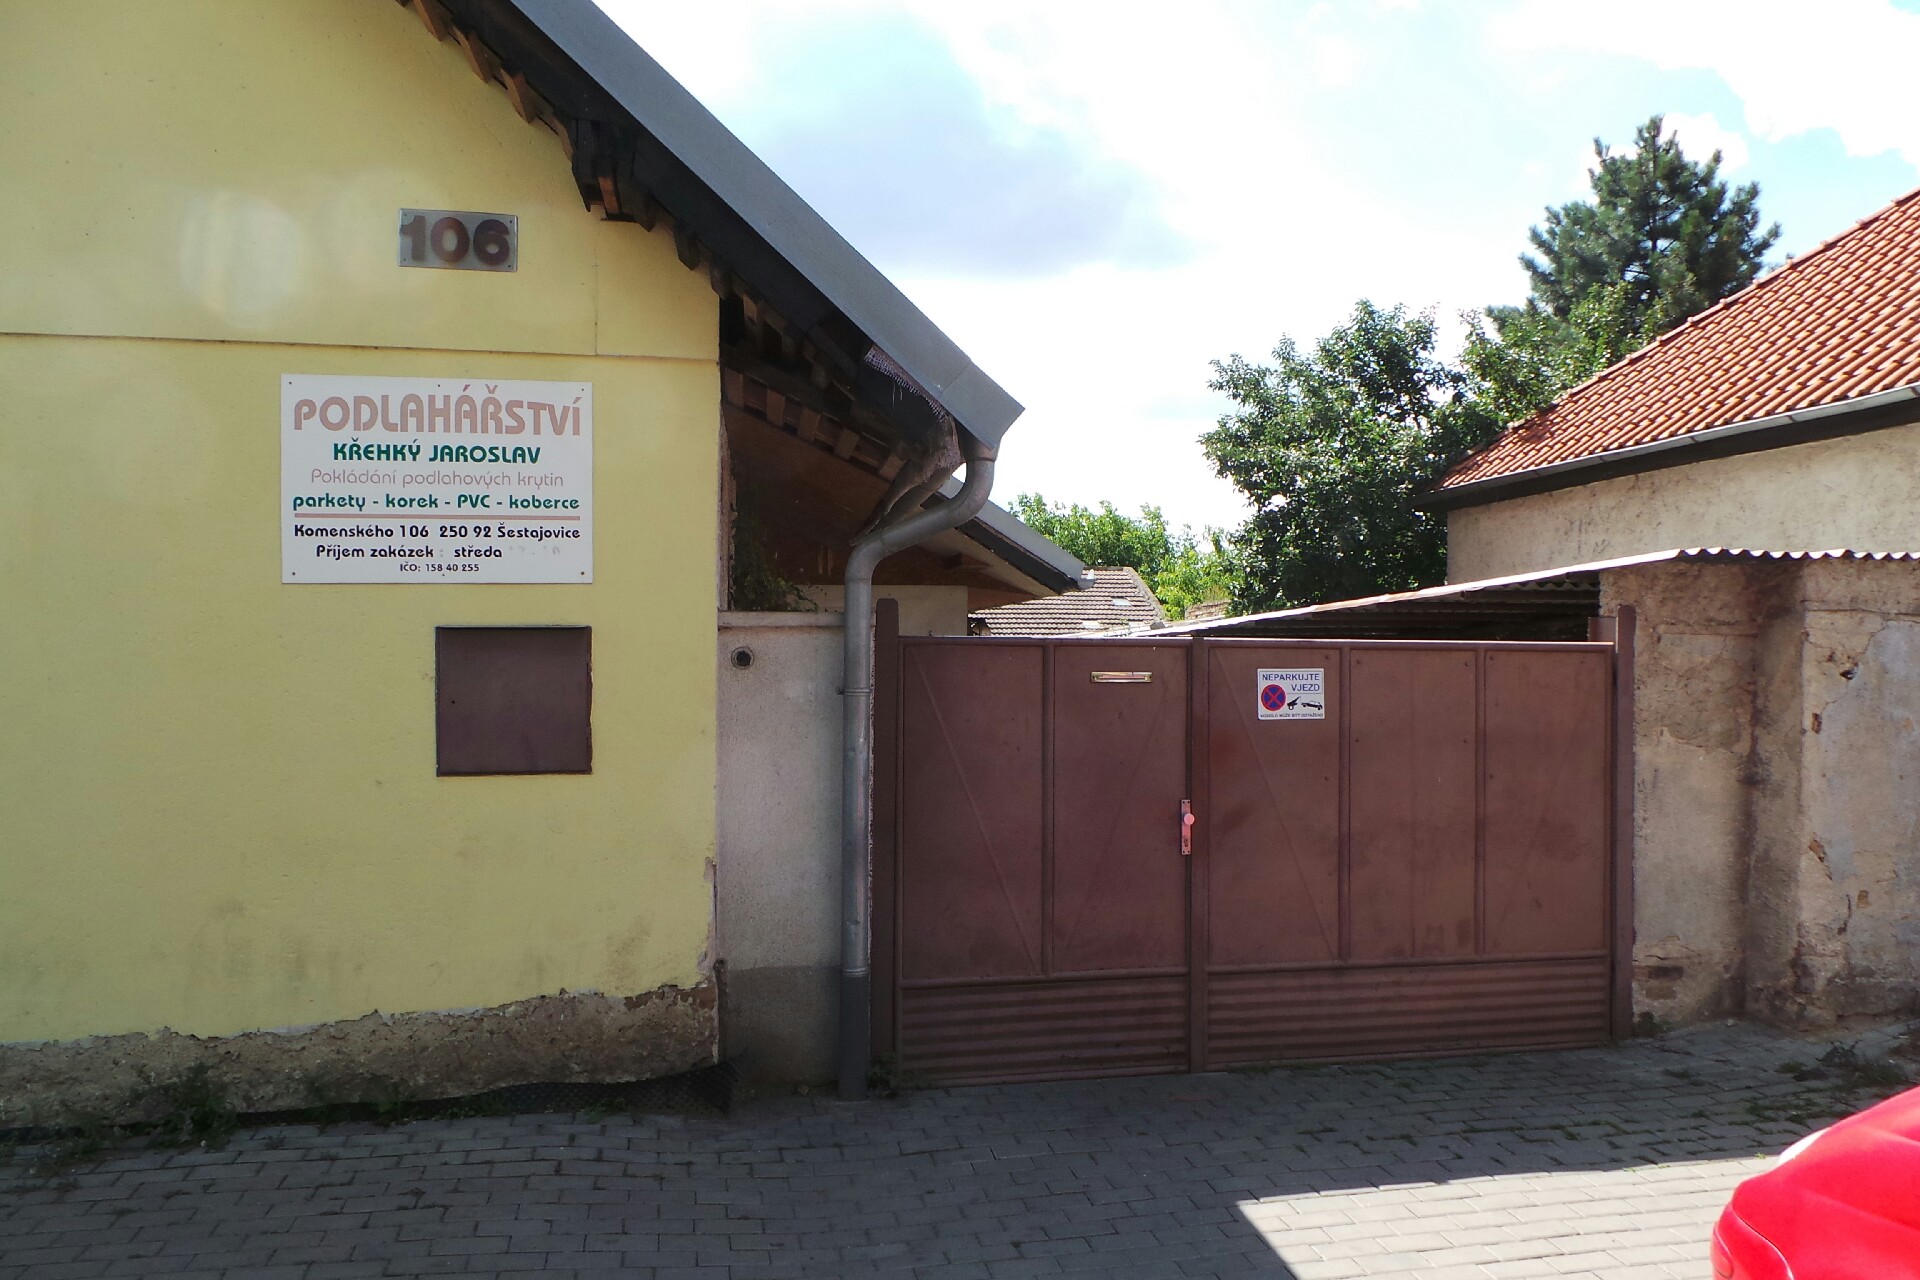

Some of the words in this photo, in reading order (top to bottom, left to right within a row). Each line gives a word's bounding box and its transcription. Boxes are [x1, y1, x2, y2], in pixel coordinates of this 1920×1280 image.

[400, 215, 511, 266] 106
[294, 383, 581, 436] PODLAHÁŘSTVÍ
[333, 437, 422, 462] KŘEHKÝ
[428, 445, 541, 464] JAROSLAV
[311, 468, 397, 485] Pokládání
[402, 470, 511, 488] podlahových
[517, 472, 564, 490] krytin
[292, 493, 366, 511] parkety
[385, 494, 439, 509] korek
[457, 494, 490, 509] PVC
[509, 495, 580, 510] koberce
[294, 523, 394, 538] Komenského
[400, 525, 429, 538] 106
[439, 525, 468, 538] 250
[473, 525, 492, 538] 92
[497, 522, 581, 542] Šestajovice
[316, 543, 365, 561] Příjem
[370, 545, 434, 558] zakázek
[453, 545, 503, 559] středa
[400, 561, 421, 572] IČO:
[425, 563, 443, 572] 158
[445, 563, 458, 572] 40
[461, 563, 480, 572] 255
[1262, 673, 1320, 681] NEPARKUJTE
[1291, 683, 1320, 692] VJEZD
